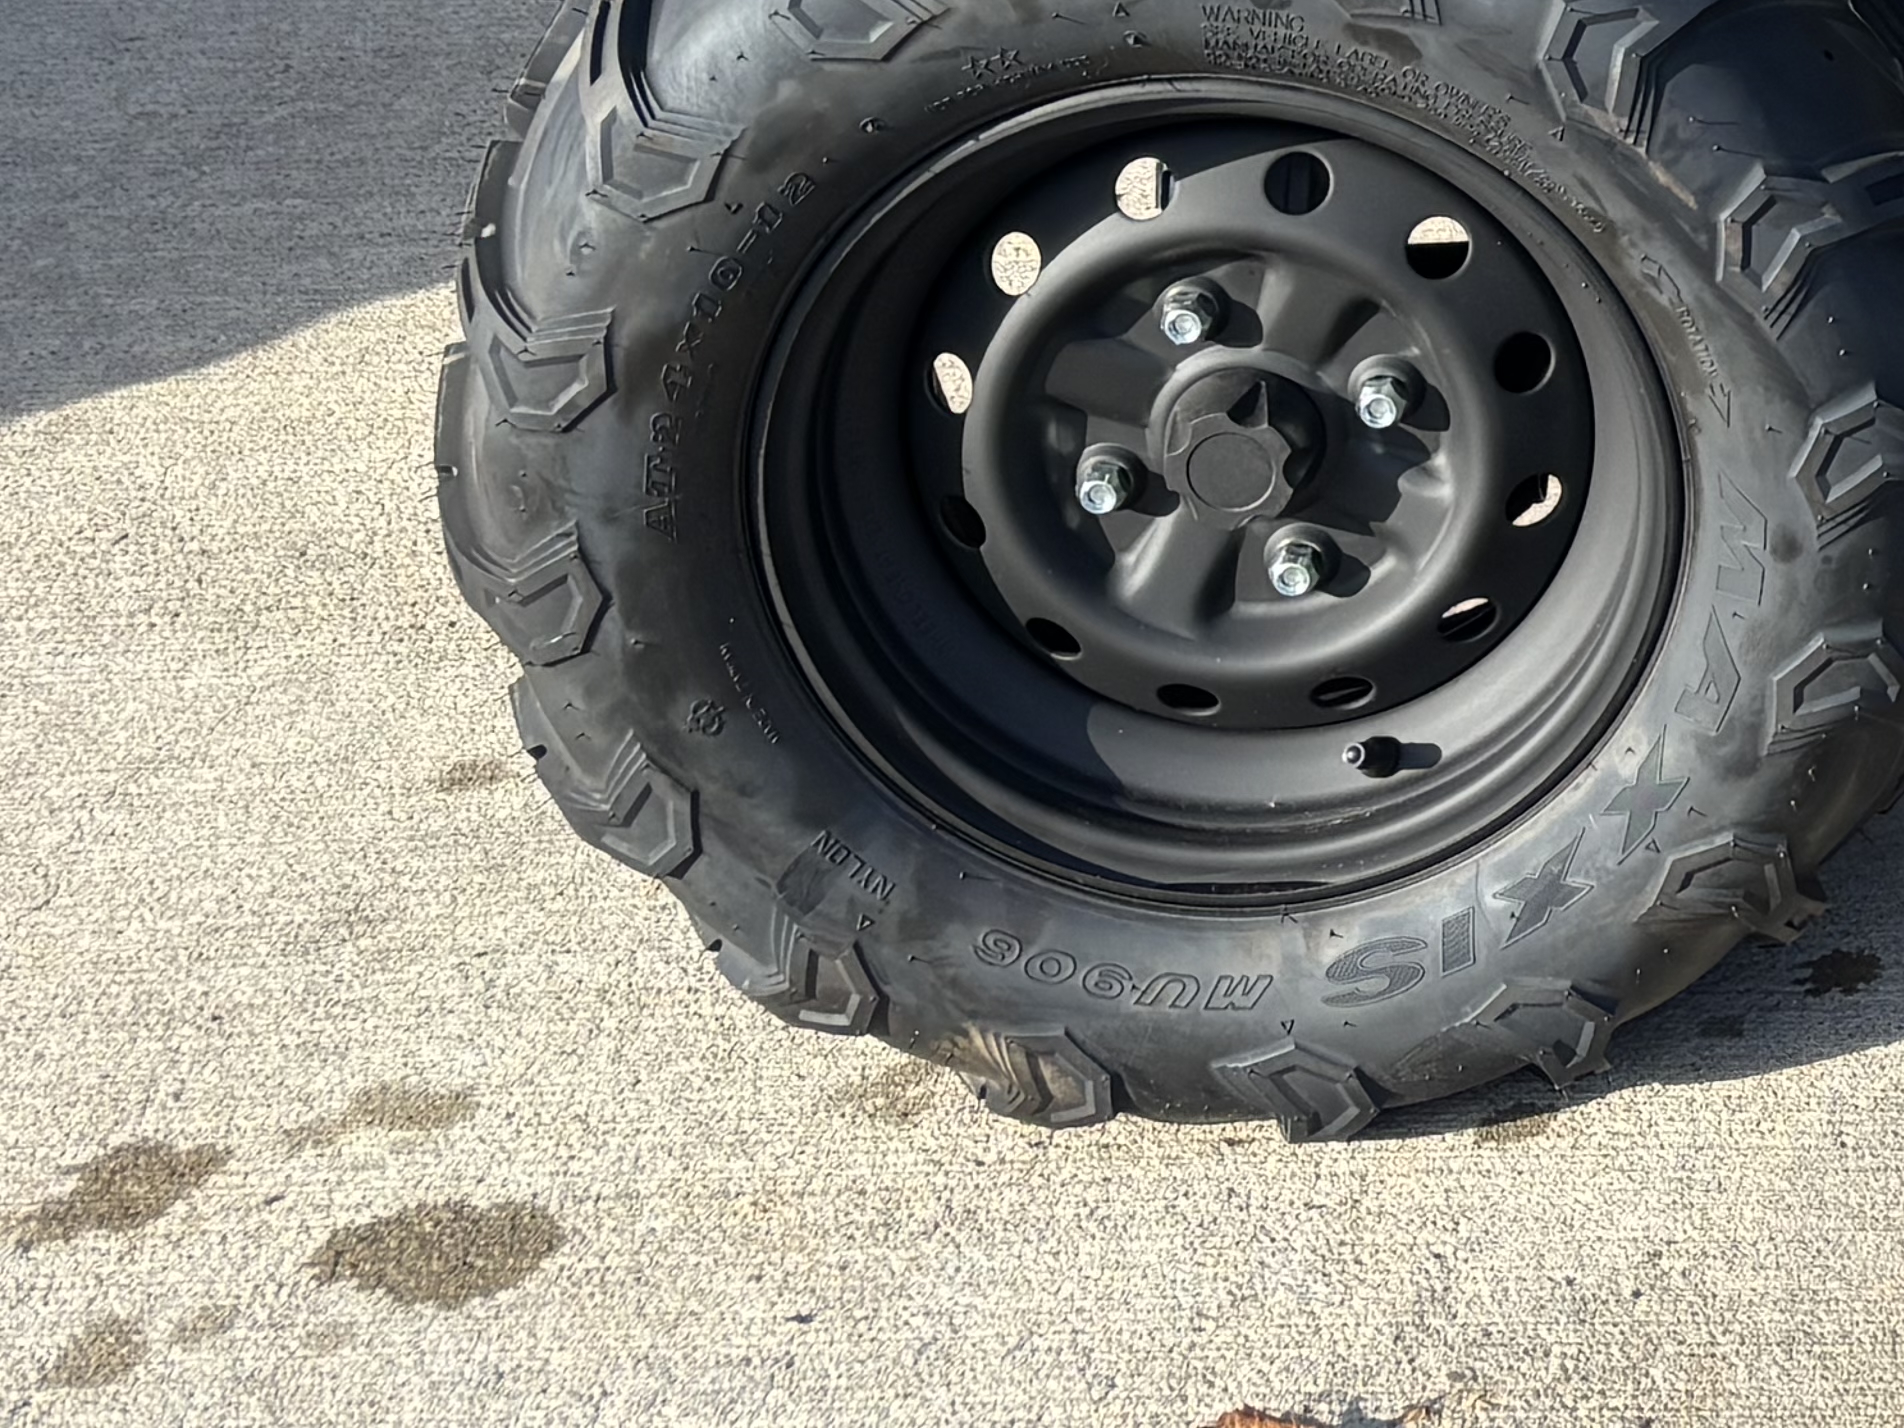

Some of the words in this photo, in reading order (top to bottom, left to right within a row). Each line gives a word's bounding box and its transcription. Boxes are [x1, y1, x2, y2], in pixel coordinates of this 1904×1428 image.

[1202, 5, 1305, 32] WARNING
[1400, 64, 1430, 87] OR
[1322, 470, 1768, 1008] MAXXIS
[809, 827, 896, 904] NYLON
[975, 926, 1276, 1013] MU906
